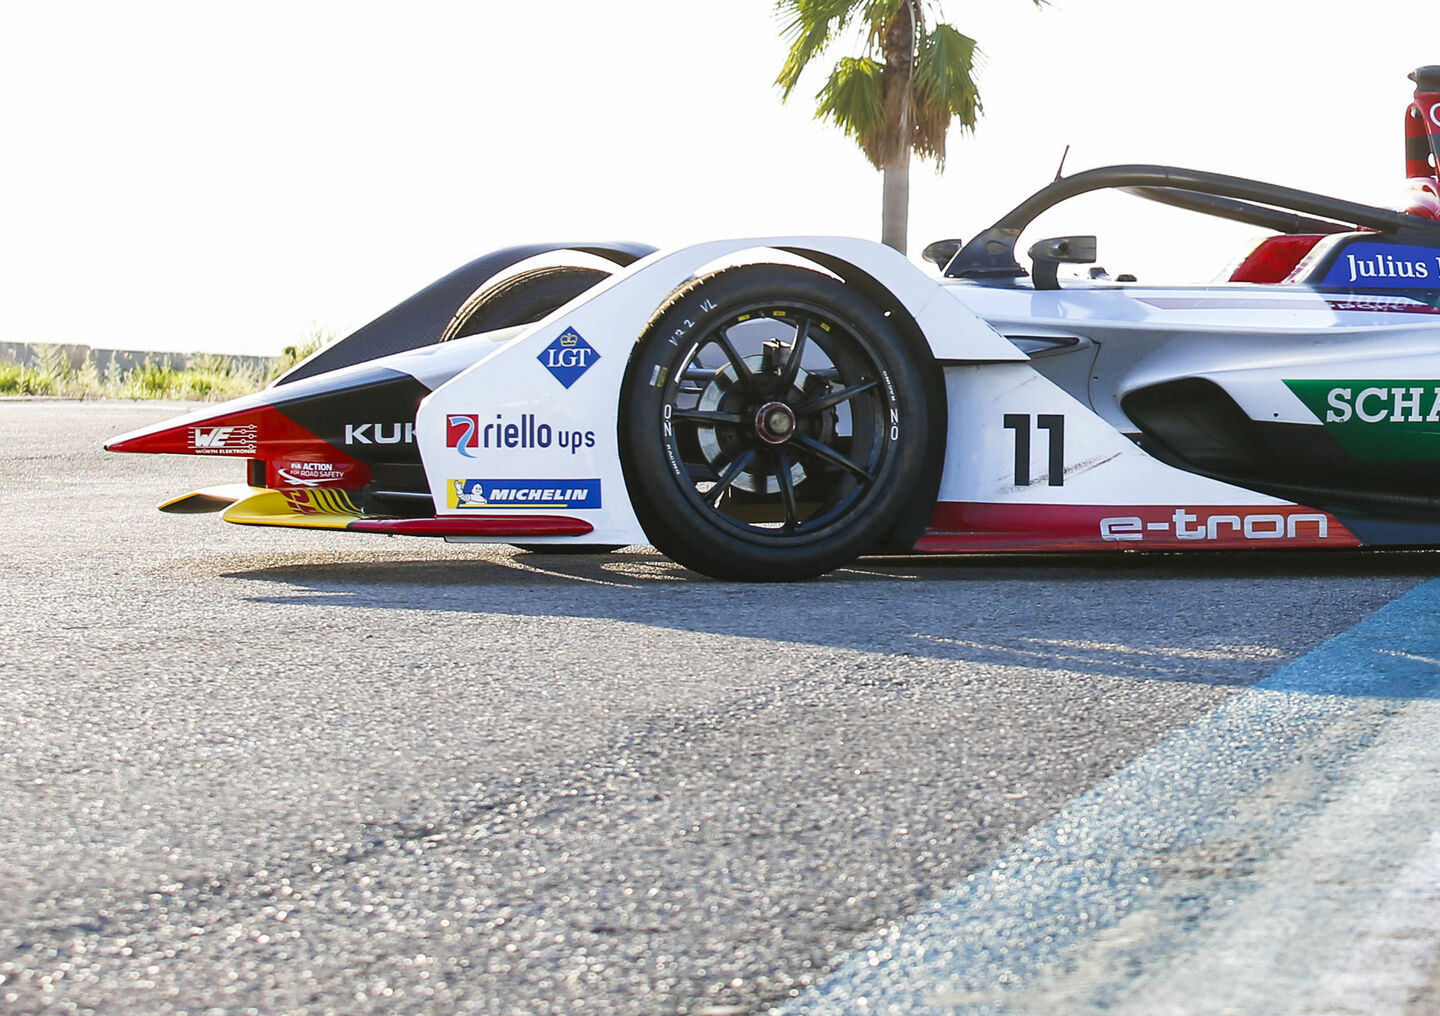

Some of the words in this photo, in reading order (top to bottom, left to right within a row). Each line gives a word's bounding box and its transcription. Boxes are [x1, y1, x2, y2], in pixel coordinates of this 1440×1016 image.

[1347, 254, 1428, 281] Julius
[547, 348, 592, 368] LGT
[194, 427, 235, 447] WE
[484, 414, 552, 448] riello
[559, 430, 595, 454] ups
[1003, 414, 1064, 486] 11
[303, 463, 333, 471] ACTION
[489, 488, 589, 502] MICHELIN
[1099, 509, 1328, 541] e-tron
